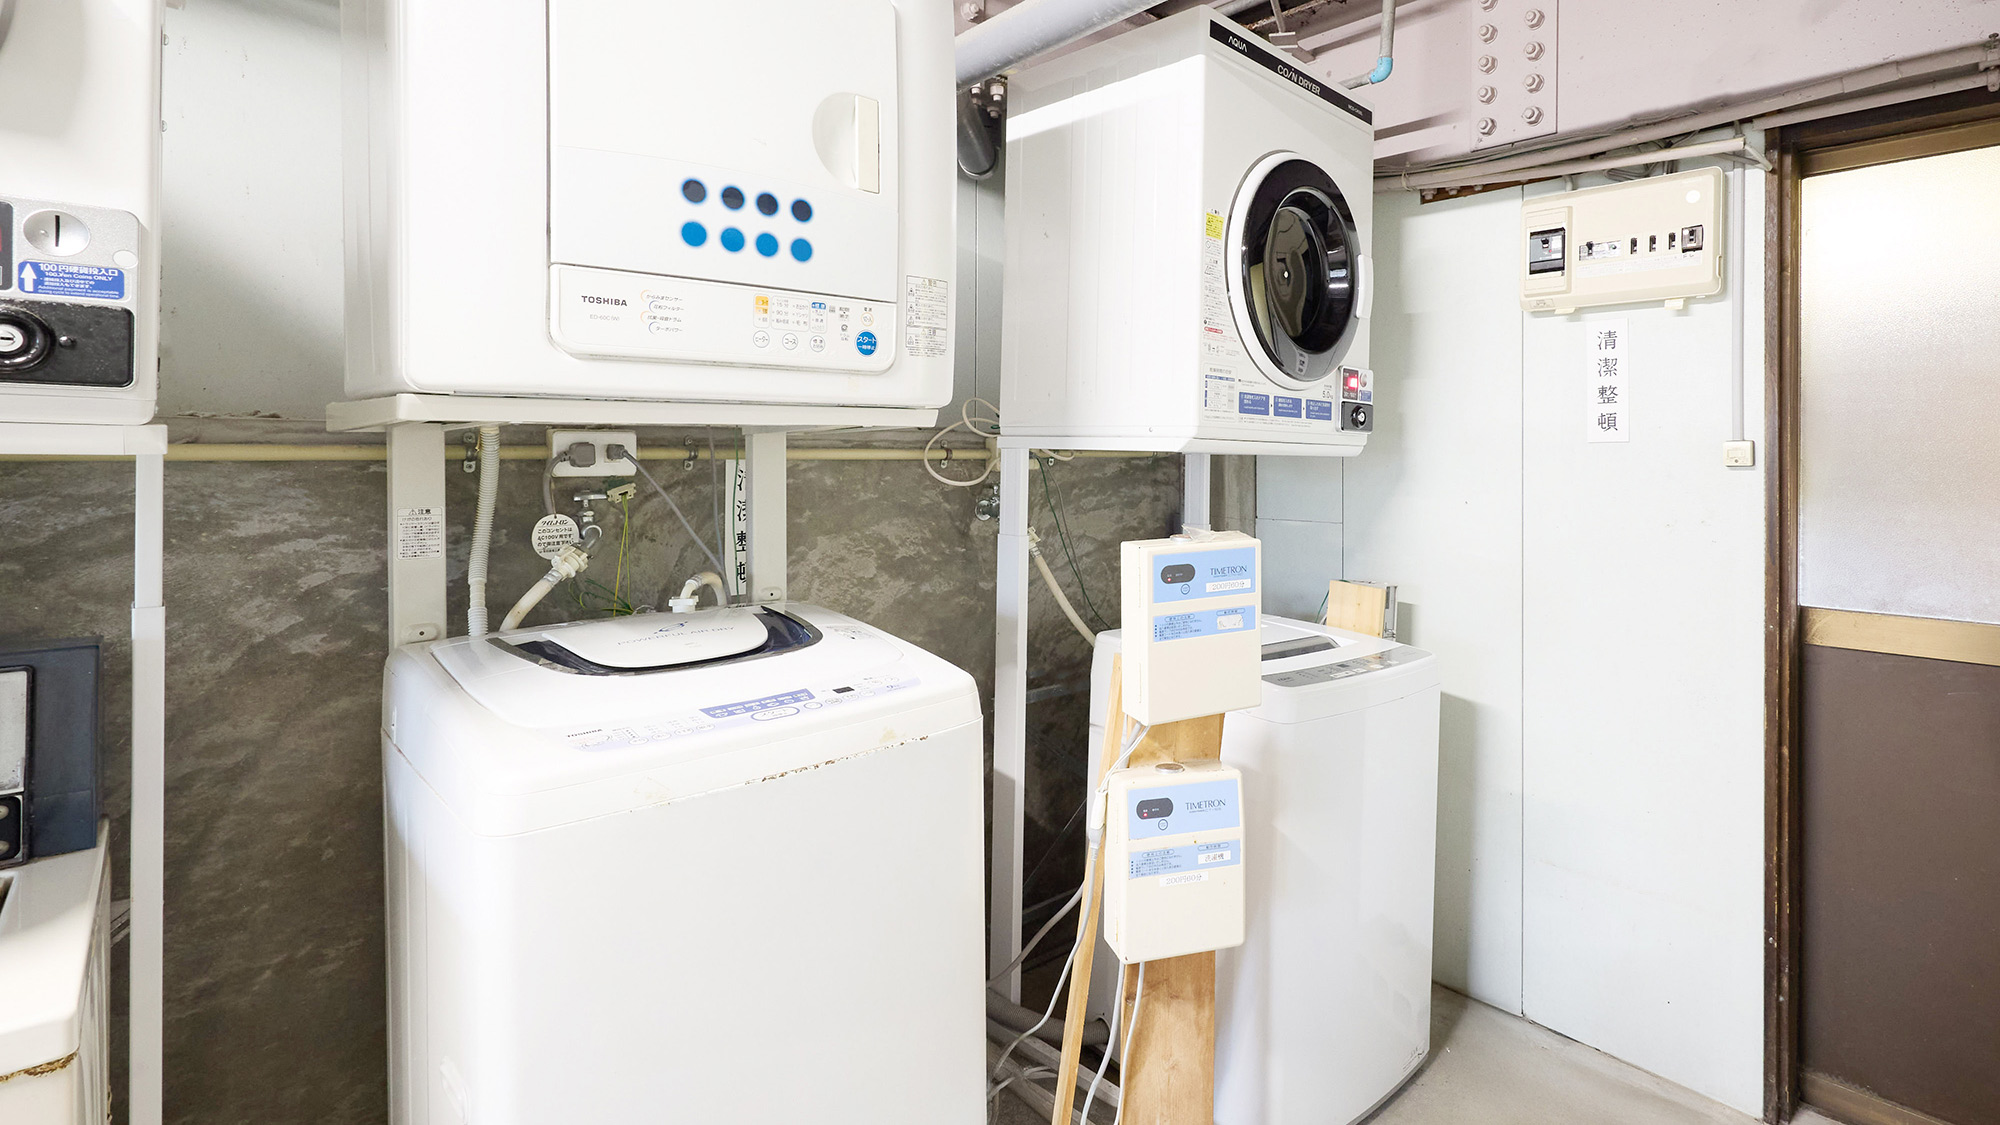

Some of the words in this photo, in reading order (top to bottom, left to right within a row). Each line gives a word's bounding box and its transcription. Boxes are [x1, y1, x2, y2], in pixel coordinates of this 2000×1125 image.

[1228, 35, 1248, 53] AQUA
[1277, 64, 1299, 84] COIN
[1298, 74, 1321, 95] DRYER
[581, 295, 628, 307] TOSHIBA
[857, 336, 877, 344] スタート
[1597, 329, 1618, 432] 清潔整頓
[1210, 565, 1247, 576] TIMETRON
[1212, 581, 1245, 591] 200円60分
[617, 632, 685, 645] POWERFUL
[1185, 799, 1226, 810] TIMETRON
[1166, 873, 1203, 885] 200円60分
